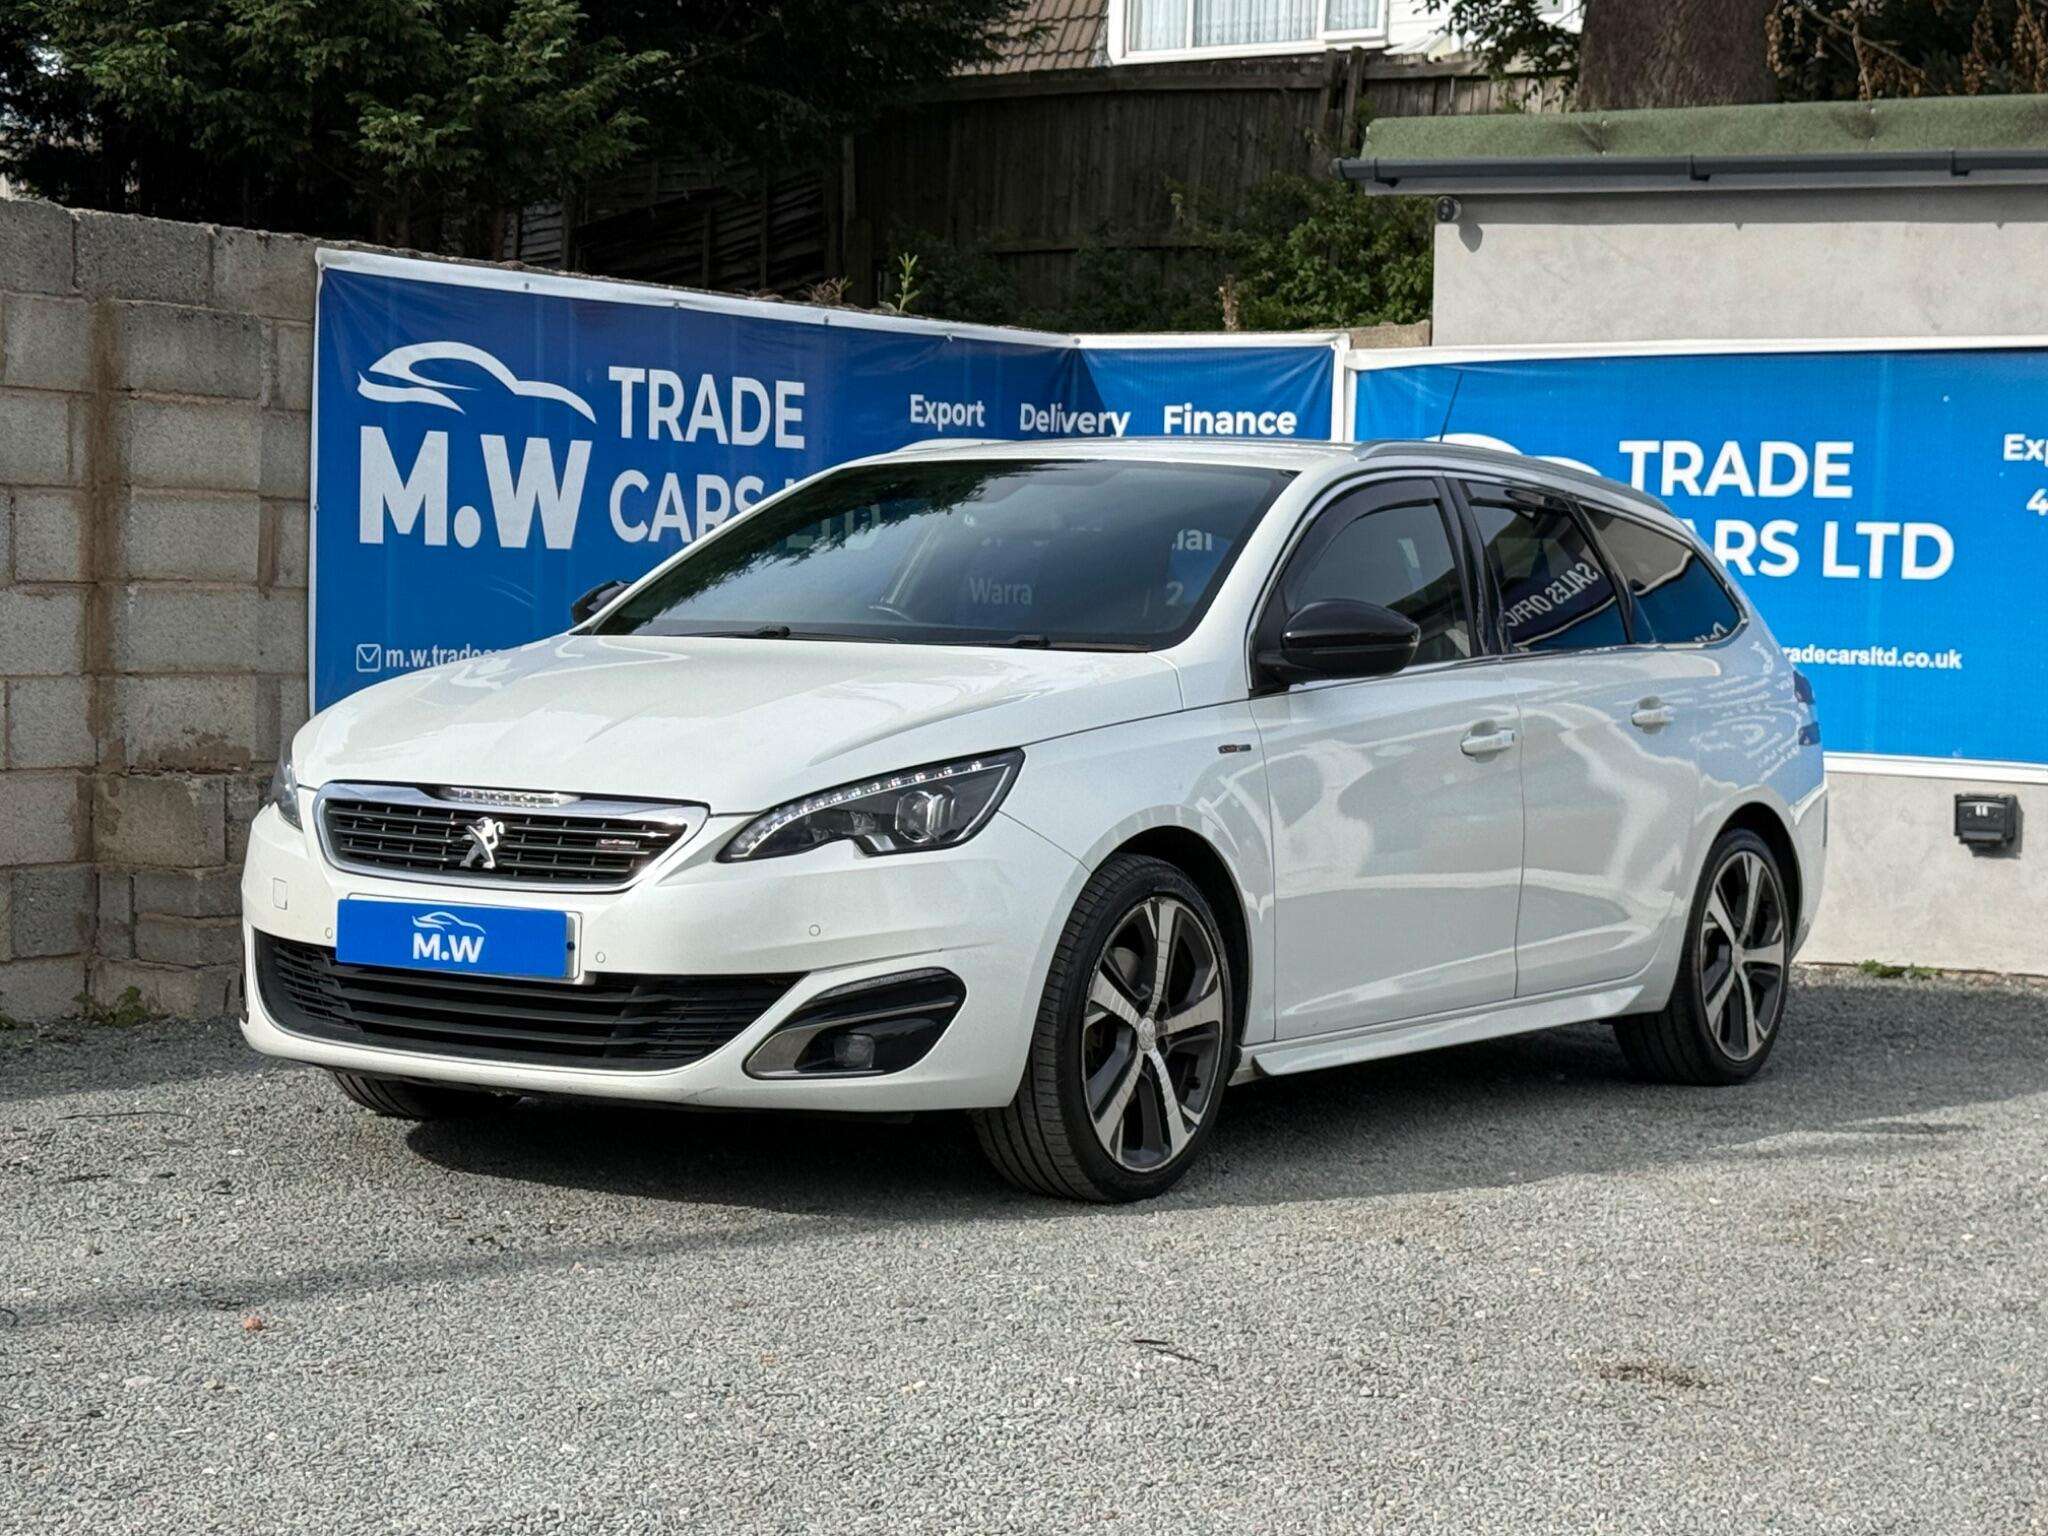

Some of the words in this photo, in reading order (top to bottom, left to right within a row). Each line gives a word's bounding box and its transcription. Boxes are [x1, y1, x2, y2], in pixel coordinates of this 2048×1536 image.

[608, 366, 806, 449] TRADE
[910, 394, 986, 432] Export
[1019, 402, 1131, 438] Delivery
[1164, 403, 1298, 436] Finance
[1619, 440, 1855, 499] TRADE
[2003, 433, 2048, 468] Ex
[360, 425, 593, 550] M.W
[1678, 518, 1800, 578] RS
[1822, 521, 1956, 580] LTD
[385, 643, 501, 668] m.w.trad
[412, 934, 485, 963] M.W
